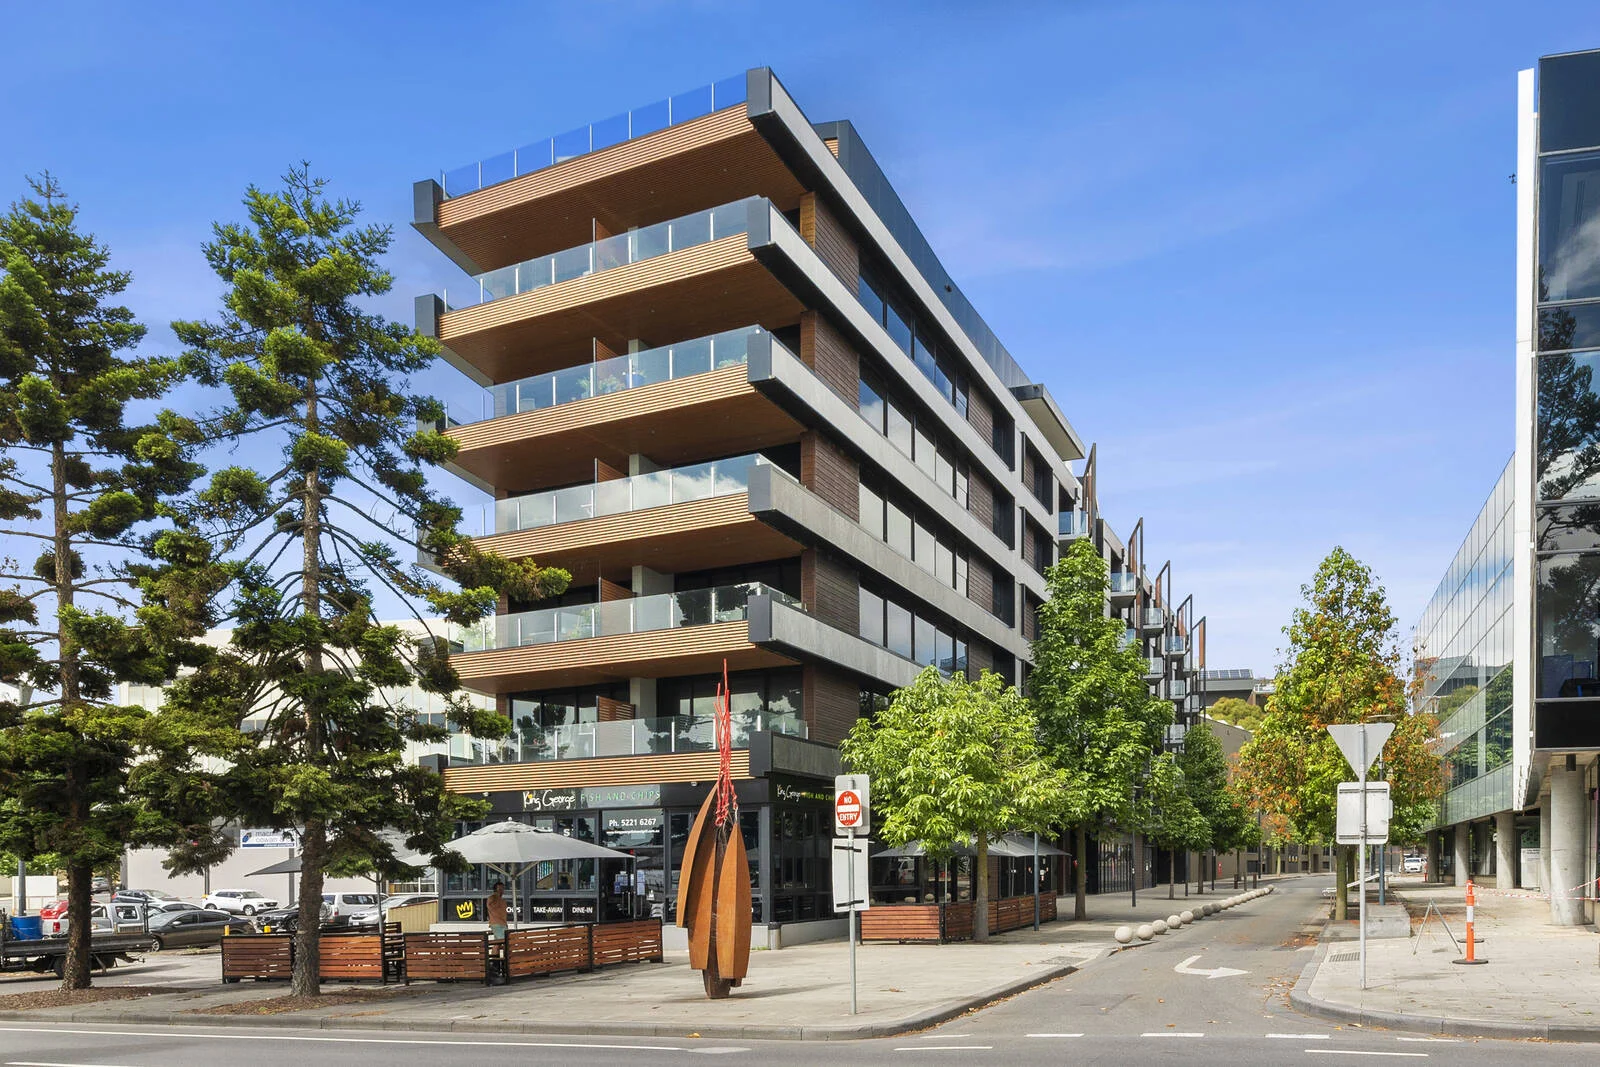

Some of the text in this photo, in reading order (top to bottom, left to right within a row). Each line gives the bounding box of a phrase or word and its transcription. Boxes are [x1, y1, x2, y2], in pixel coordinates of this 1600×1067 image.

[523, 789, 576, 811] King George
[580, 790, 660, 802] FISH AND CHIPS
[843, 795, 853, 804] NO
[839, 812, 858, 821] ENTRY
[608, 817, 657, 827] Ph. 5221 6267
[571, 906, 593, 914] DINE-IN
